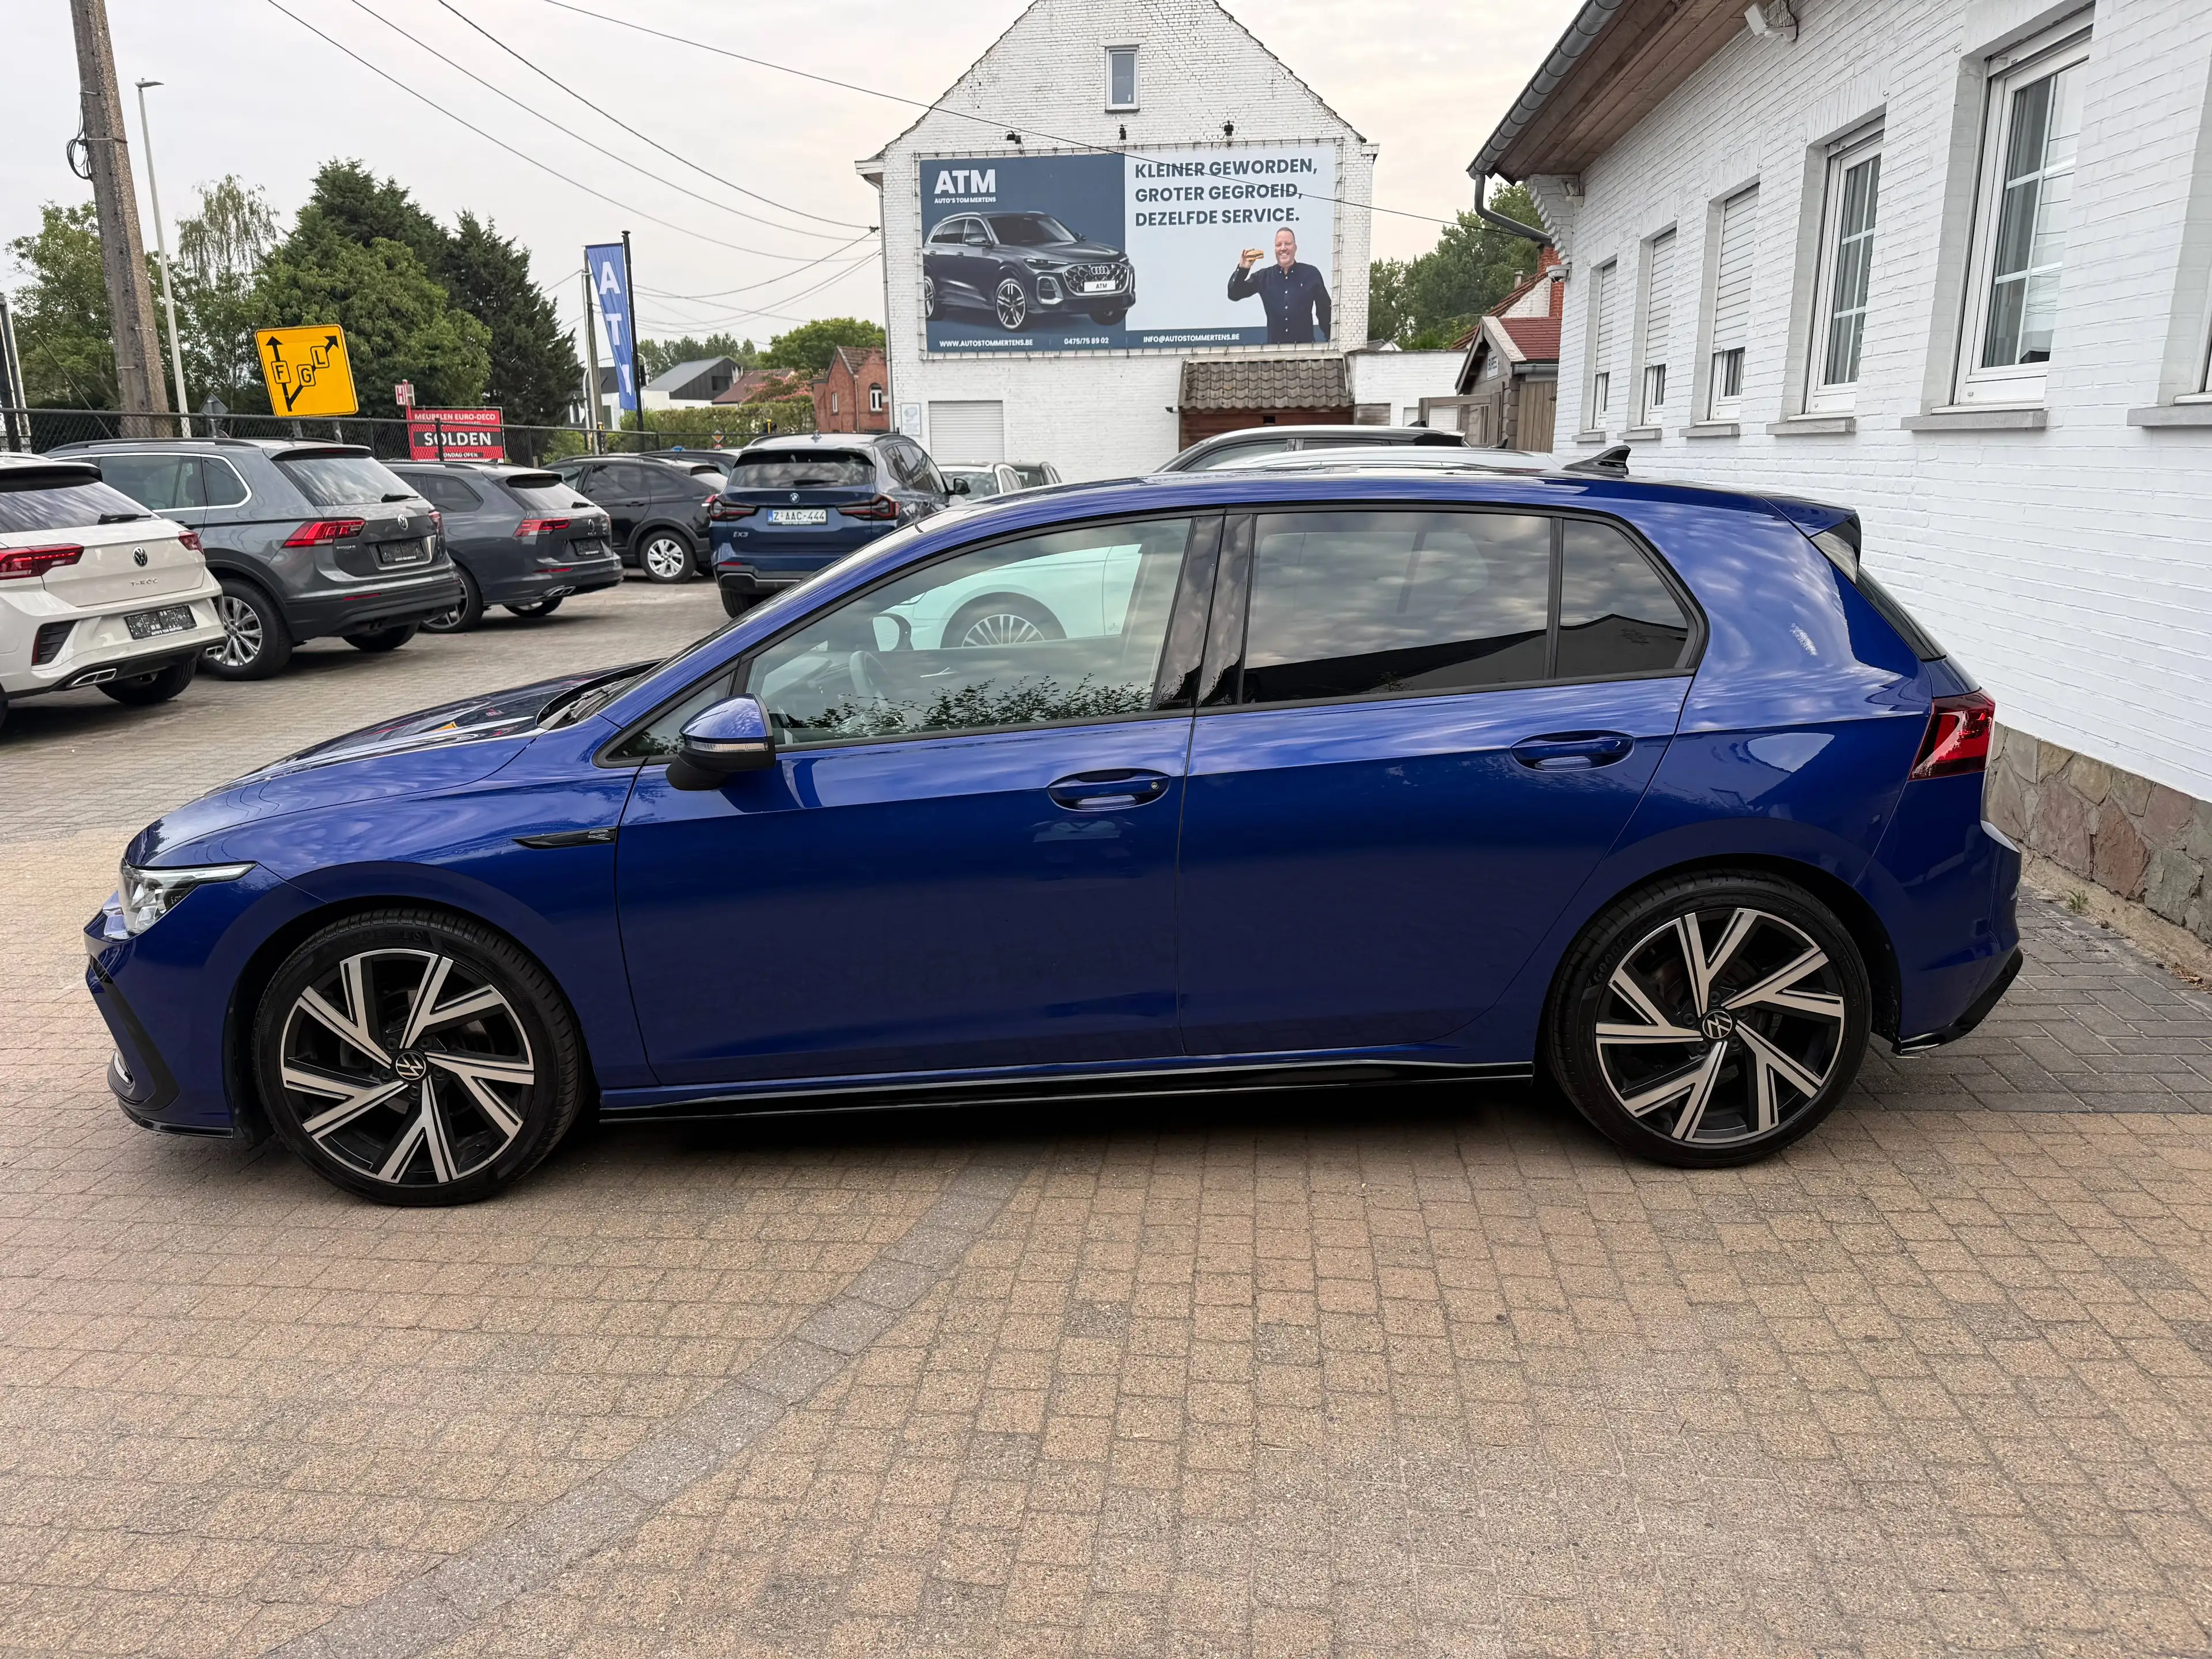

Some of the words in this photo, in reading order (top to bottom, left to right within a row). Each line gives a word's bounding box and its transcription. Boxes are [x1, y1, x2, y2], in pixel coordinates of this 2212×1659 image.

[1135, 162, 1205, 178] KLEINER
[1209, 158, 1317, 175] GEWORDEN,
[934, 169, 996, 194] ATM
[1135, 187, 1205, 202] GROTER
[1209, 183, 1303, 199] GEGROEID,
[1135, 210, 1218, 226] DEZELFDE
[1222, 207, 1300, 224] SERVICE.
[940, 339, 1033, 347] WWW.AUTOSTOMMERTENS.BE
[1143, 333, 1240, 343] INFO@AUTOSTOMMERTENS.BE
[315, 350, 325, 365] L
[275, 365, 284, 380] F
[301, 368, 312, 383] G
[424, 432, 491, 446] SOLDEN
